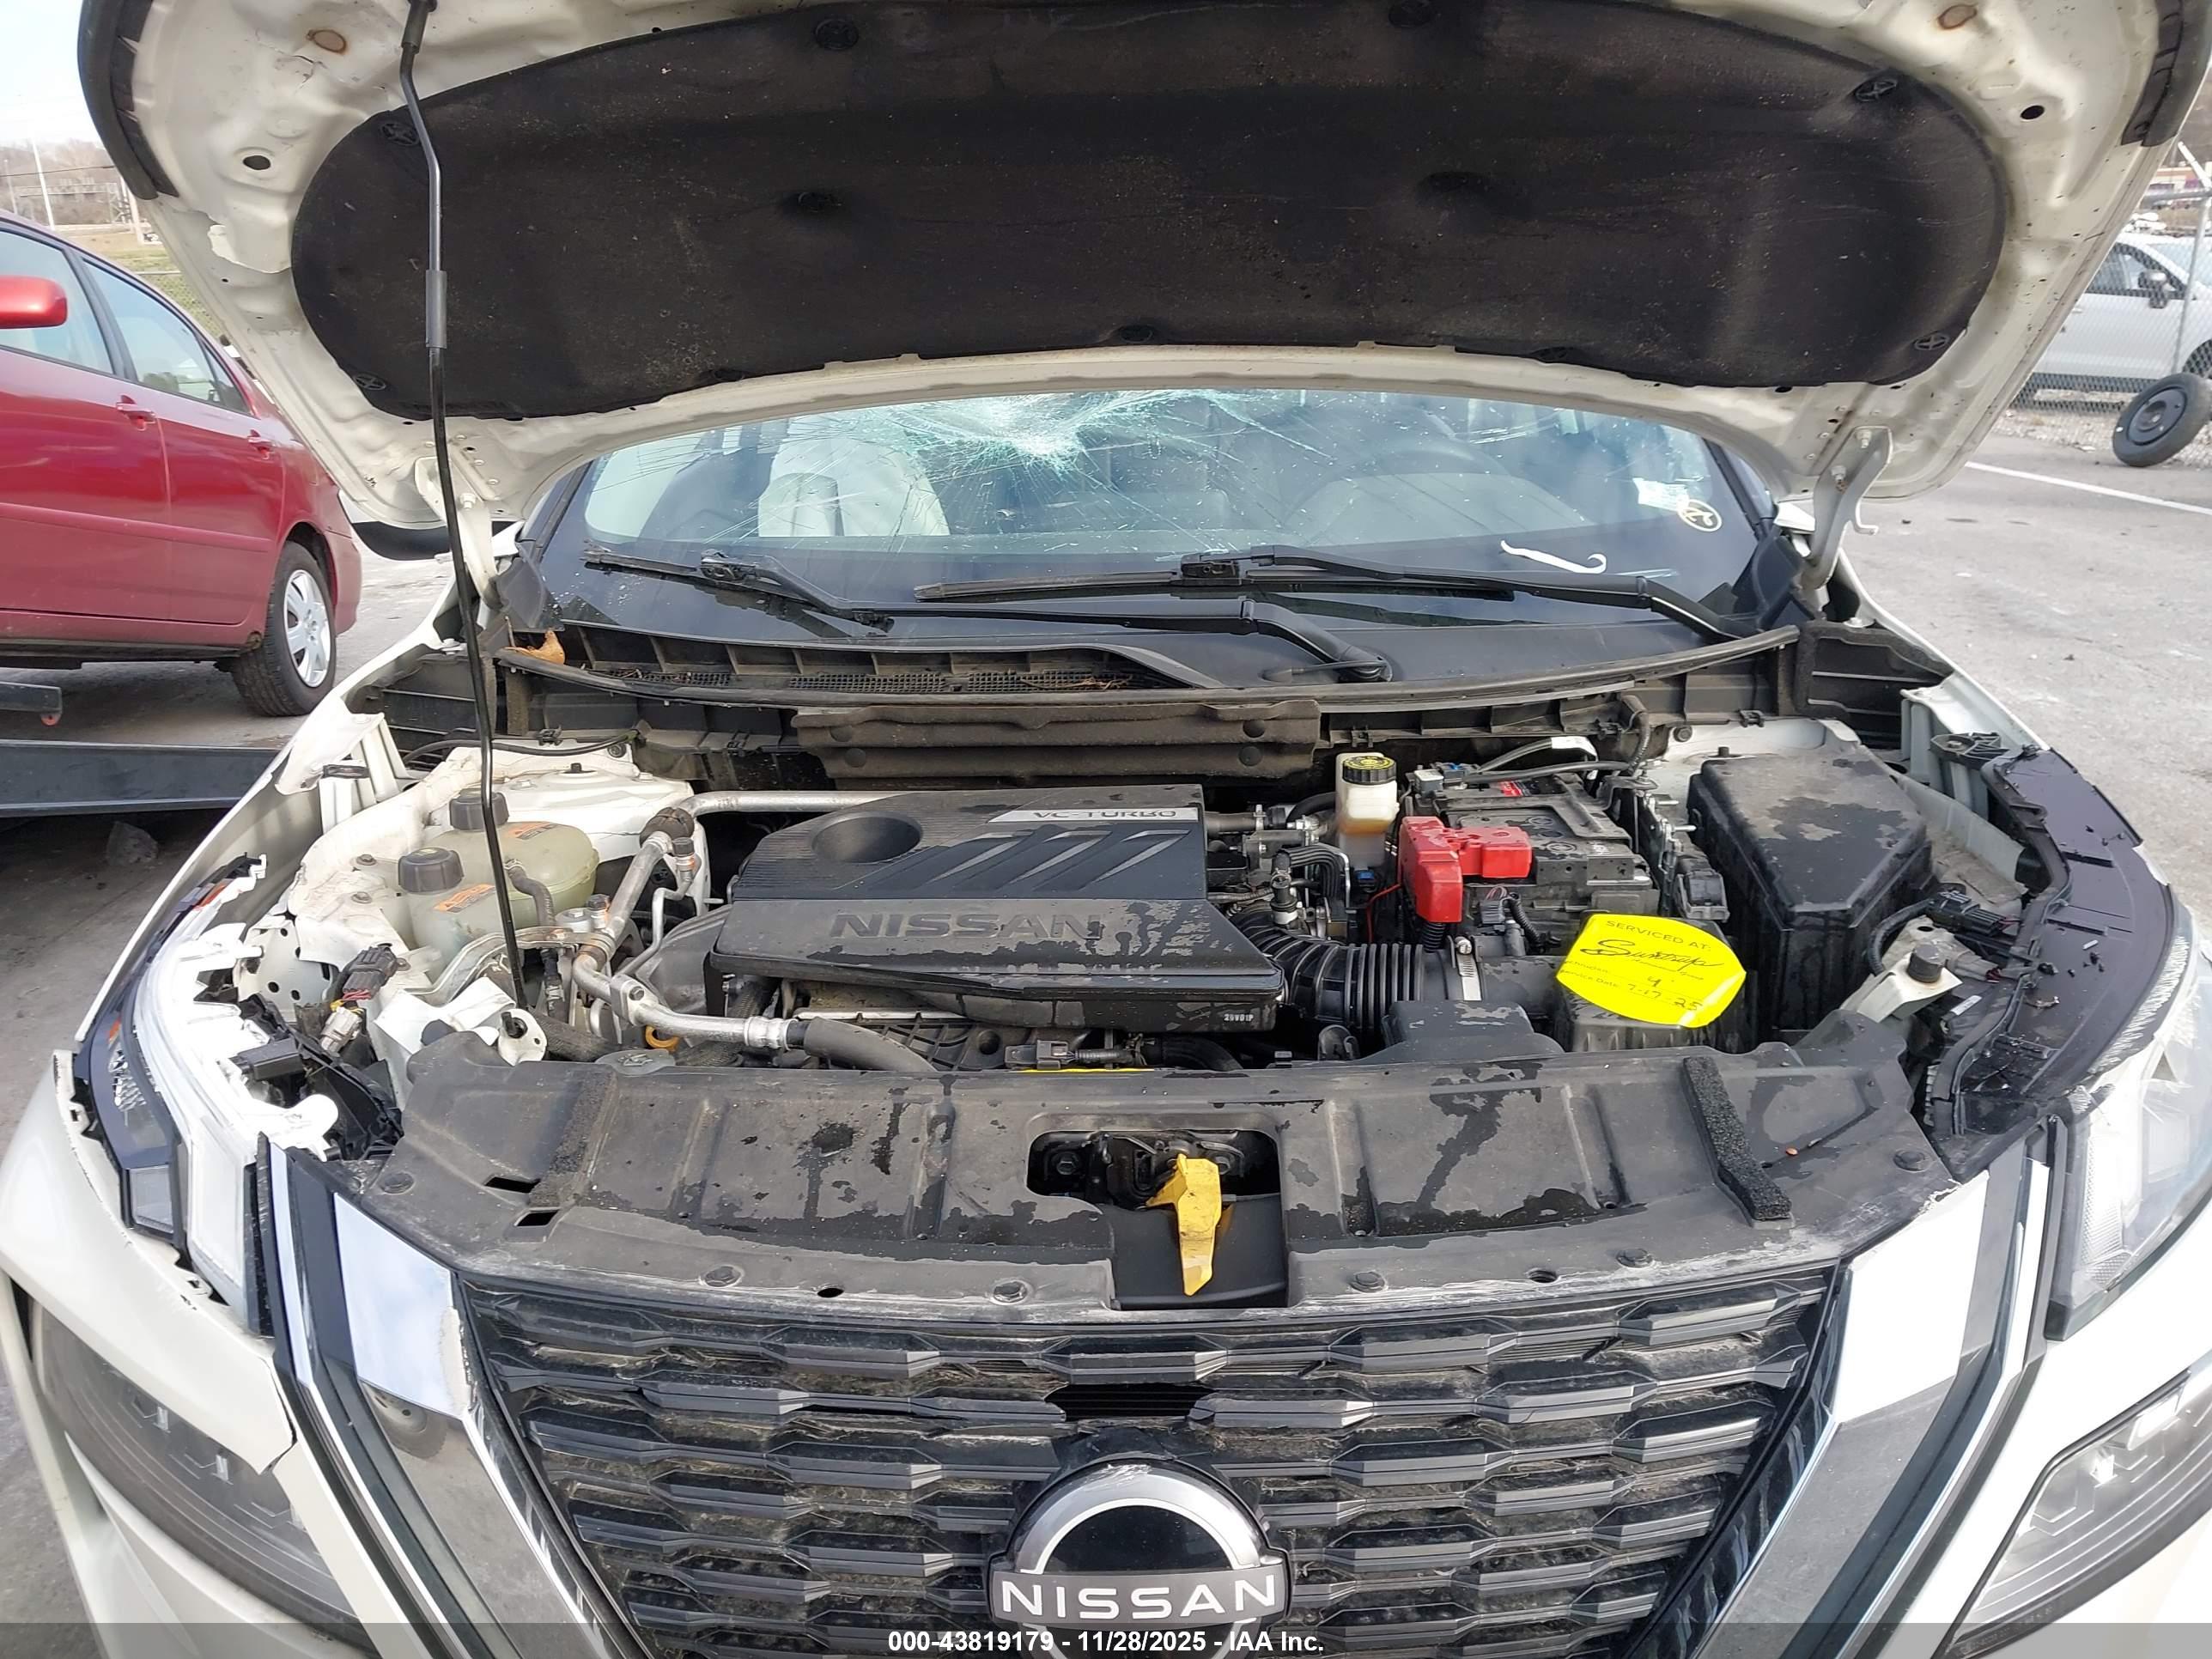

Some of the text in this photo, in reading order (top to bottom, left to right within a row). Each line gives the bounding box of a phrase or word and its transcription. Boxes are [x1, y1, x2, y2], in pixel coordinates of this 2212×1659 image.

[1032, 809, 1176, 819] VC-TURBO
[829, 913, 1103, 939] NISSAN
[1606, 920, 1711, 952] SERVICED AT:
[1001, 1574, 1275, 1620] NISSAN
